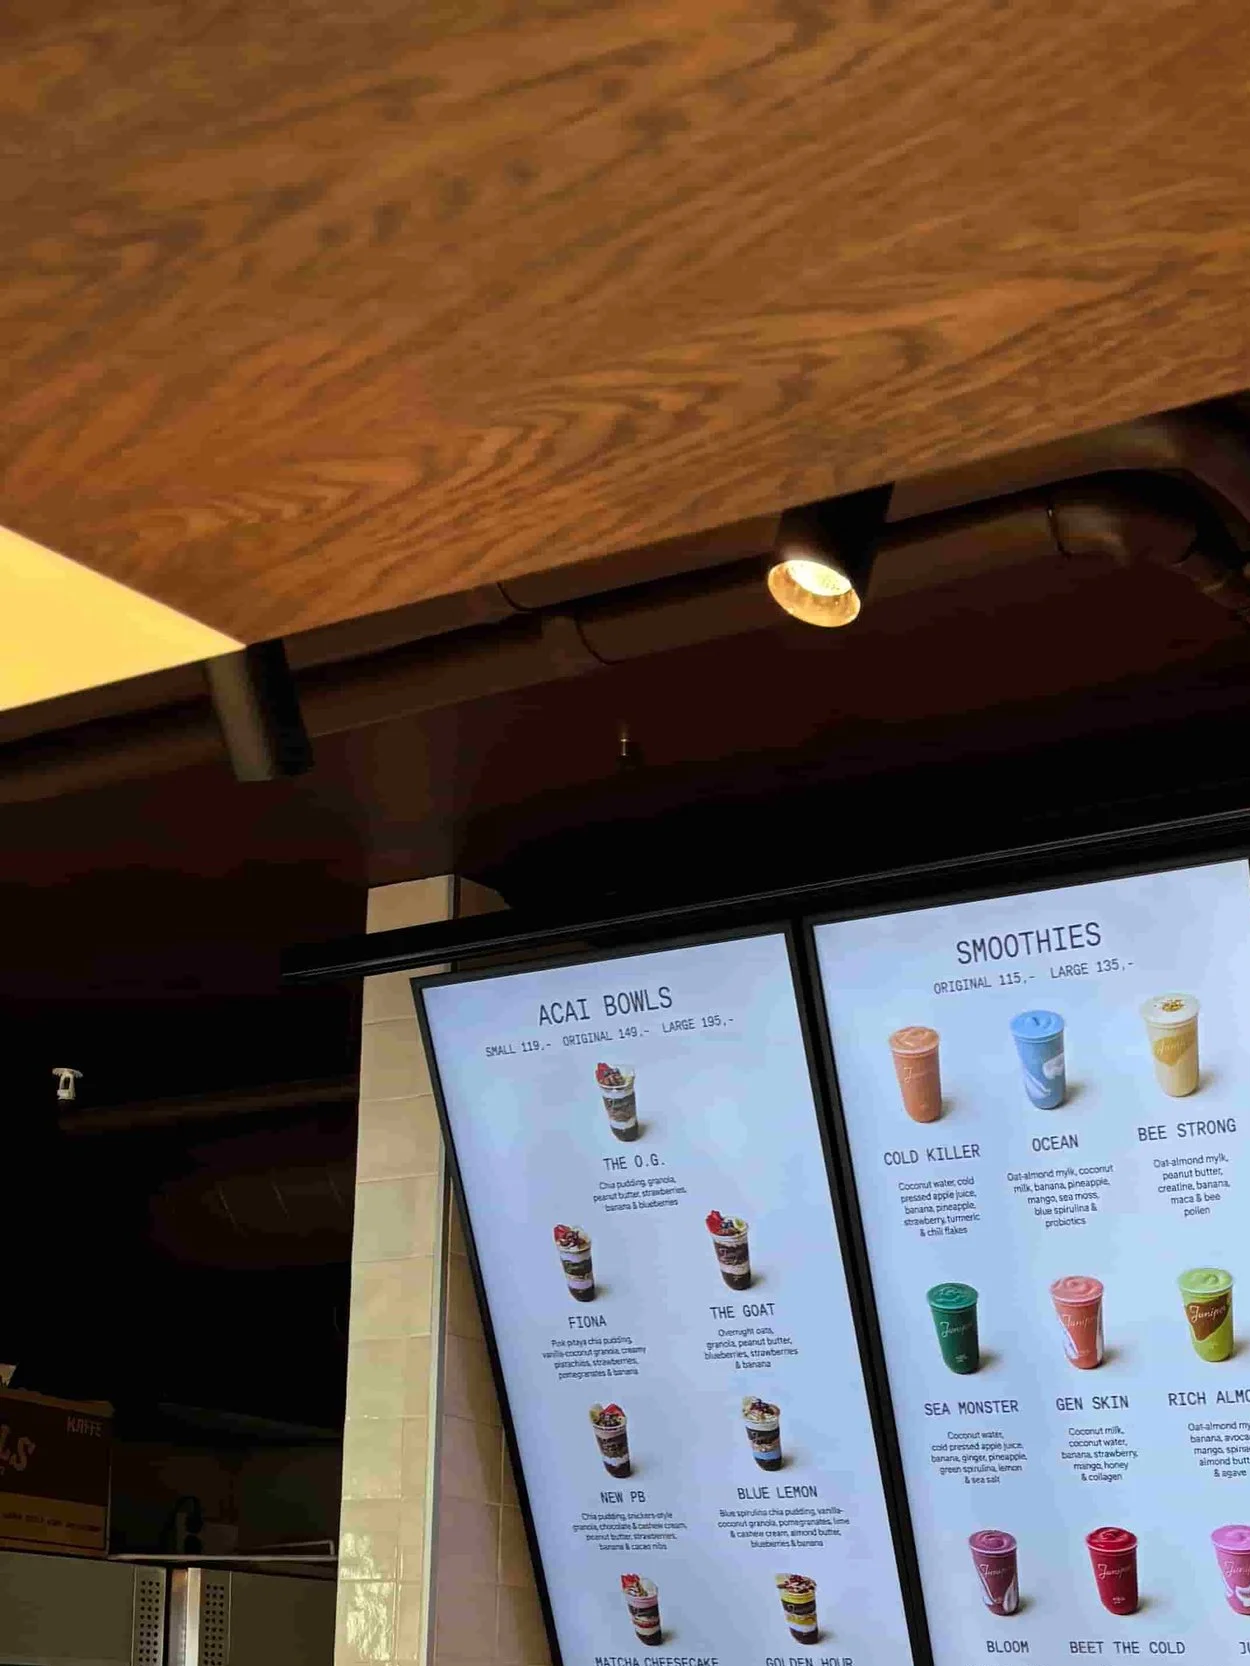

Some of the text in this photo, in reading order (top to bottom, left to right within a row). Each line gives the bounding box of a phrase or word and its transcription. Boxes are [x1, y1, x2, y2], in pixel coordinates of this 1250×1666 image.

[957, 922, 1101, 964] SMOOTHIES
[934, 976, 992, 994] ORIGINAL
[1050, 963, 1089, 978] LARGE
[539, 987, 672, 1026] ACAI BOWLS
[486, 1044, 516, 1057] SMALL
[563, 1031, 614, 1047] ORIGINAL
[662, 1017, 696, 1034] LARGE
[1138, 1118, 1236, 1141] BEE STRONG
[1032, 1134, 1078, 1152] OCEAN
[603, 1153, 665, 1171] THE O.G.
[884, 1144, 981, 1166] COLD KILLER
[709, 1303, 775, 1319] THE GOAT
[568, 1315, 607, 1329] FIONA
[1056, 1396, 1128, 1411] GEN SKIN
[1168, 1392, 1206, 1406] RICH
[924, 1400, 1019, 1416] SEA MONSTER
[600, 1489, 646, 1503] NEW PB
[737, 1486, 818, 1500] BLUE LEMON
[986, 1640, 1029, 1653] BLOOM
[1069, 1641, 1186, 1655] BEET THE COLD
